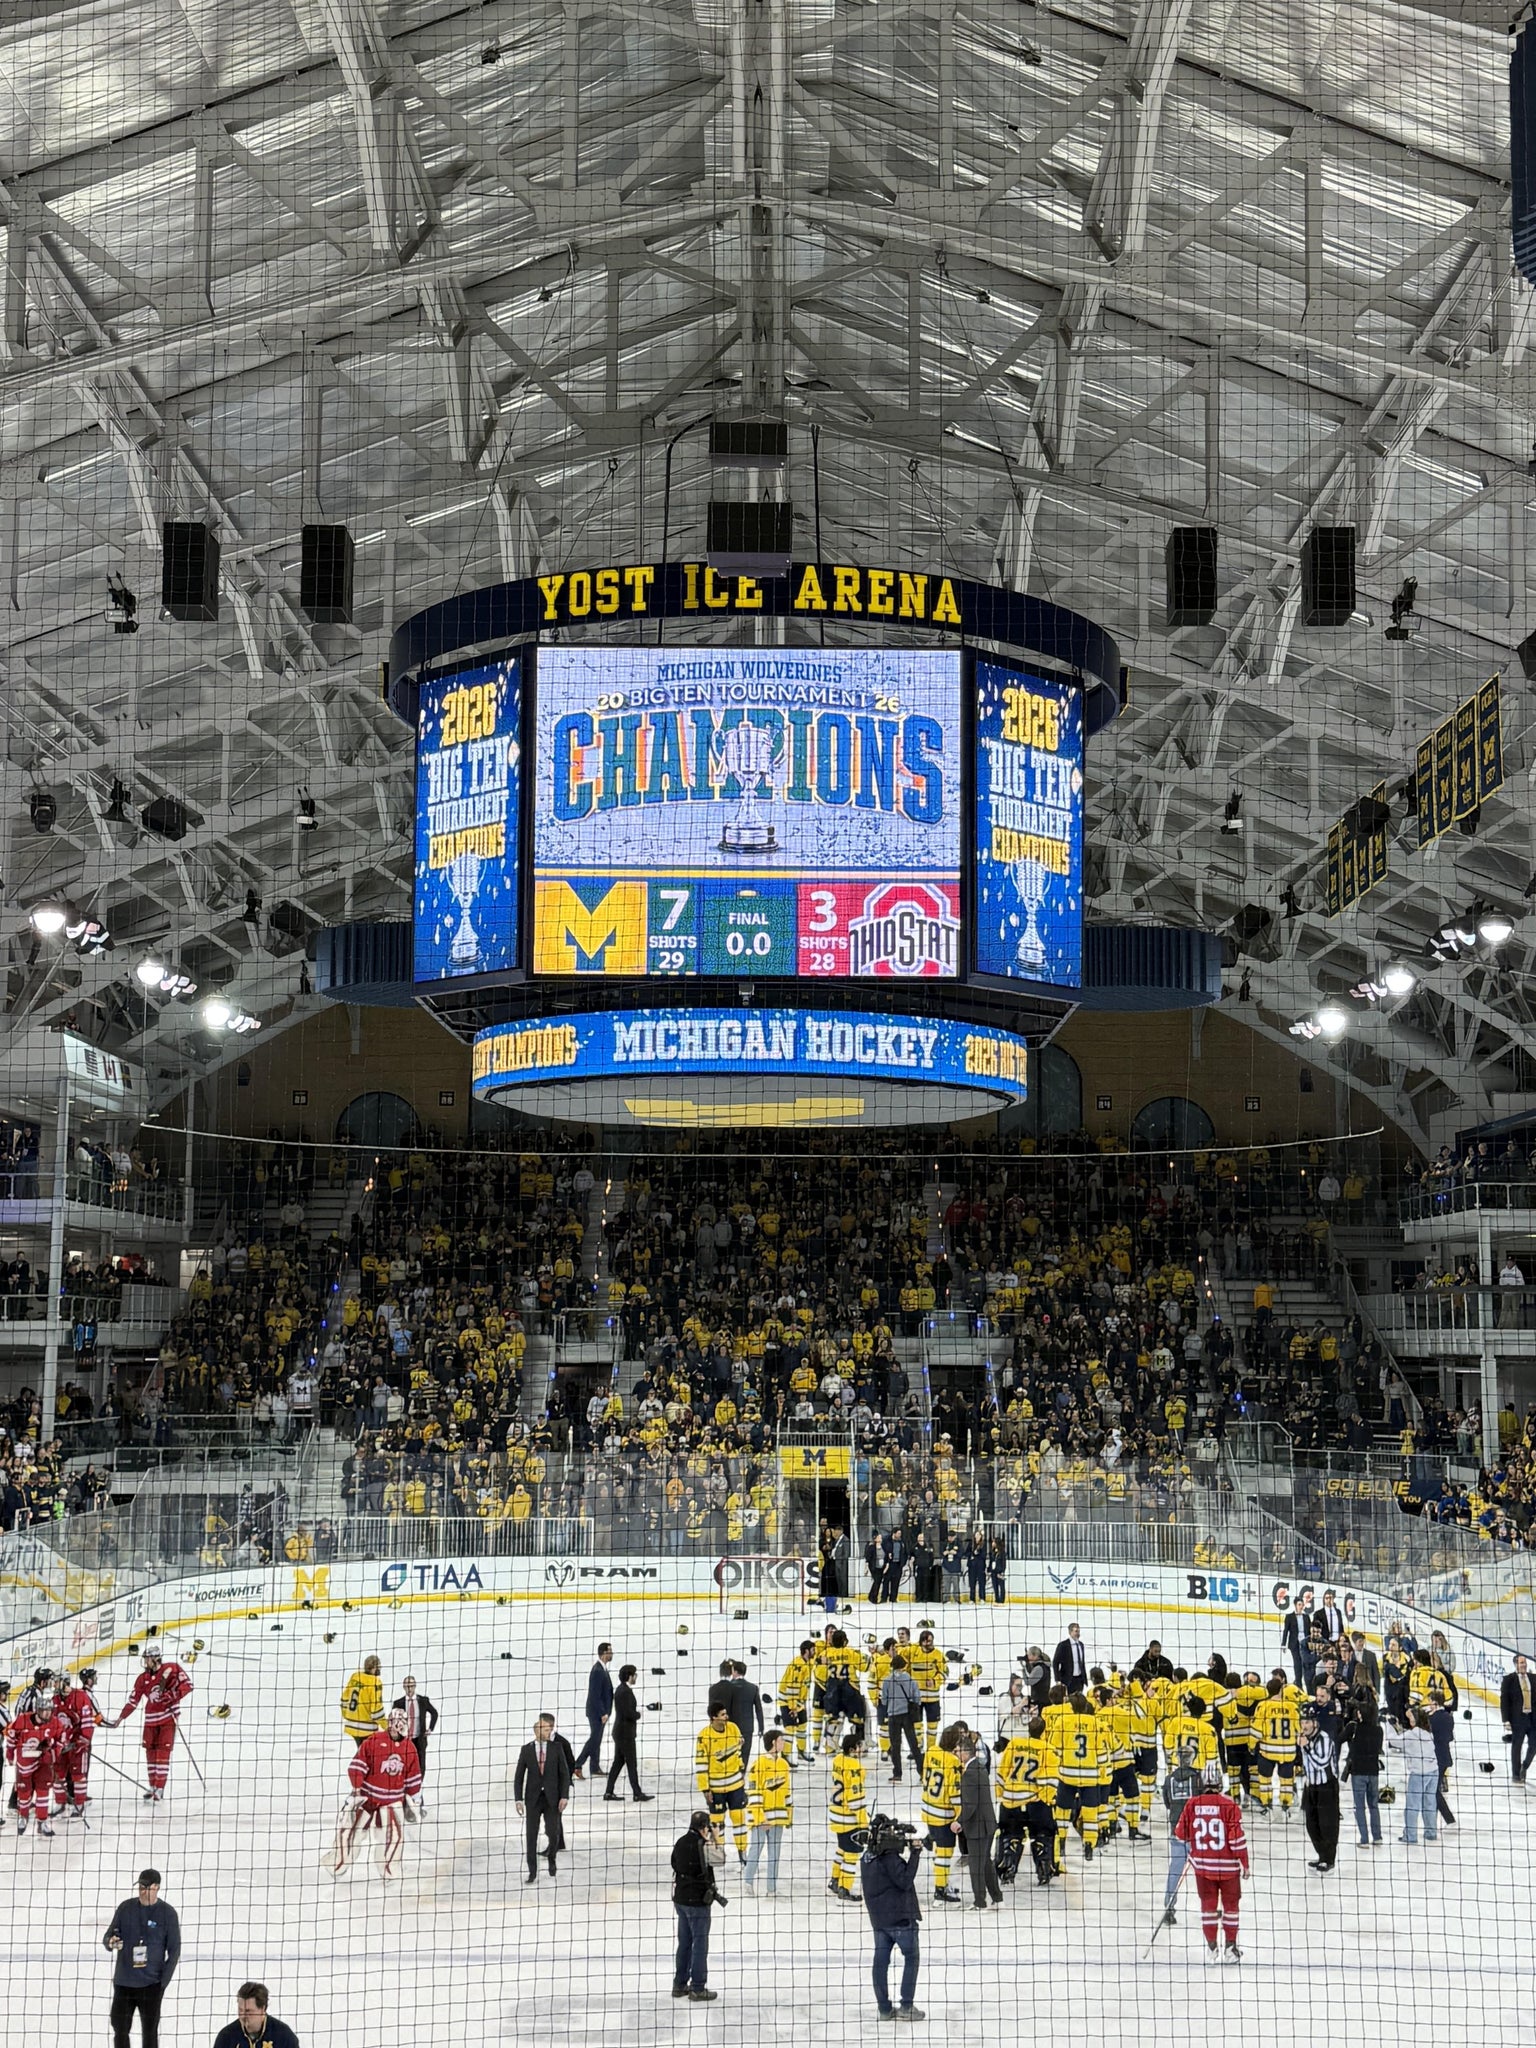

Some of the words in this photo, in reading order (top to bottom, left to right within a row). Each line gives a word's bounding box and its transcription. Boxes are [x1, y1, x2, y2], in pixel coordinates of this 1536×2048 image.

[538, 566, 654, 620] YOST
[684, 565, 762, 608] ICE
[794, 565, 962, 624] ARENA
[657, 661, 739, 683] MICHIGAN
[742, 660, 842, 683] WOLVERINES
[597, 692, 624, 710] 20
[630, 688, 665, 706] BIG
[670, 684, 713, 702] TEN
[718, 683, 871, 707] TOURNAMENT
[875, 694, 900, 712] 26
[442, 682, 497, 747] 2026
[1002, 687, 1060, 752] 2026
[428, 744, 463, 805] BIG
[469, 736, 511, 796] TEN
[554, 707, 944, 824] CHAMPIONS
[989, 740, 1026, 799] BIG
[1030, 750, 1073, 810] TEN
[428, 790, 509, 836] TOURNAMENT
[989, 793, 1073, 842] TOURNAMENT
[428, 822, 506, 870] CHAMPIONS
[991, 825, 1071, 876] CHAMPIONS
[660, 890, 690, 930] 7
[729, 913, 769, 925] FINAL
[809, 890, 838, 932] 3
[534, 881, 648, 974] M
[649, 936, 697, 949] SHOTS
[726, 933, 771, 956] 0.0
[799, 936, 848, 950] SHOTS
[659, 952, 685, 970] 29
[810, 953, 836, 971] 28
[492, 1025, 577, 1074] CHAMPIONS
[613, 1020, 797, 1062] MICHIGAN
[806, 1020, 938, 1069] HOCKEY
[966, 1034, 998, 1077] 2026
[803, 1449, 827, 1466] M
[1327, 1478, 1354, 1491] GO
[1358, 1480, 1411, 1495] BLUE
[1403, 1495, 1421, 1504] YOU
[292, 1566, 330, 1599] M
[414, 1564, 484, 1590] TIAA
[580, 1567, 657, 1578] RAM
[713, 1560, 821, 1590] OIKOS
[1078, 1578, 1098, 1587] U.S.
[1100, 1580, 1118, 1588] AIR
[1121, 1580, 1159, 1590] FORCE
[1270, 1717, 1290, 1739] 18
[1075, 1734, 1087, 1758] 3
[1010, 1756, 1040, 1782] 72
[1192, 1818, 1226, 1851] 29
